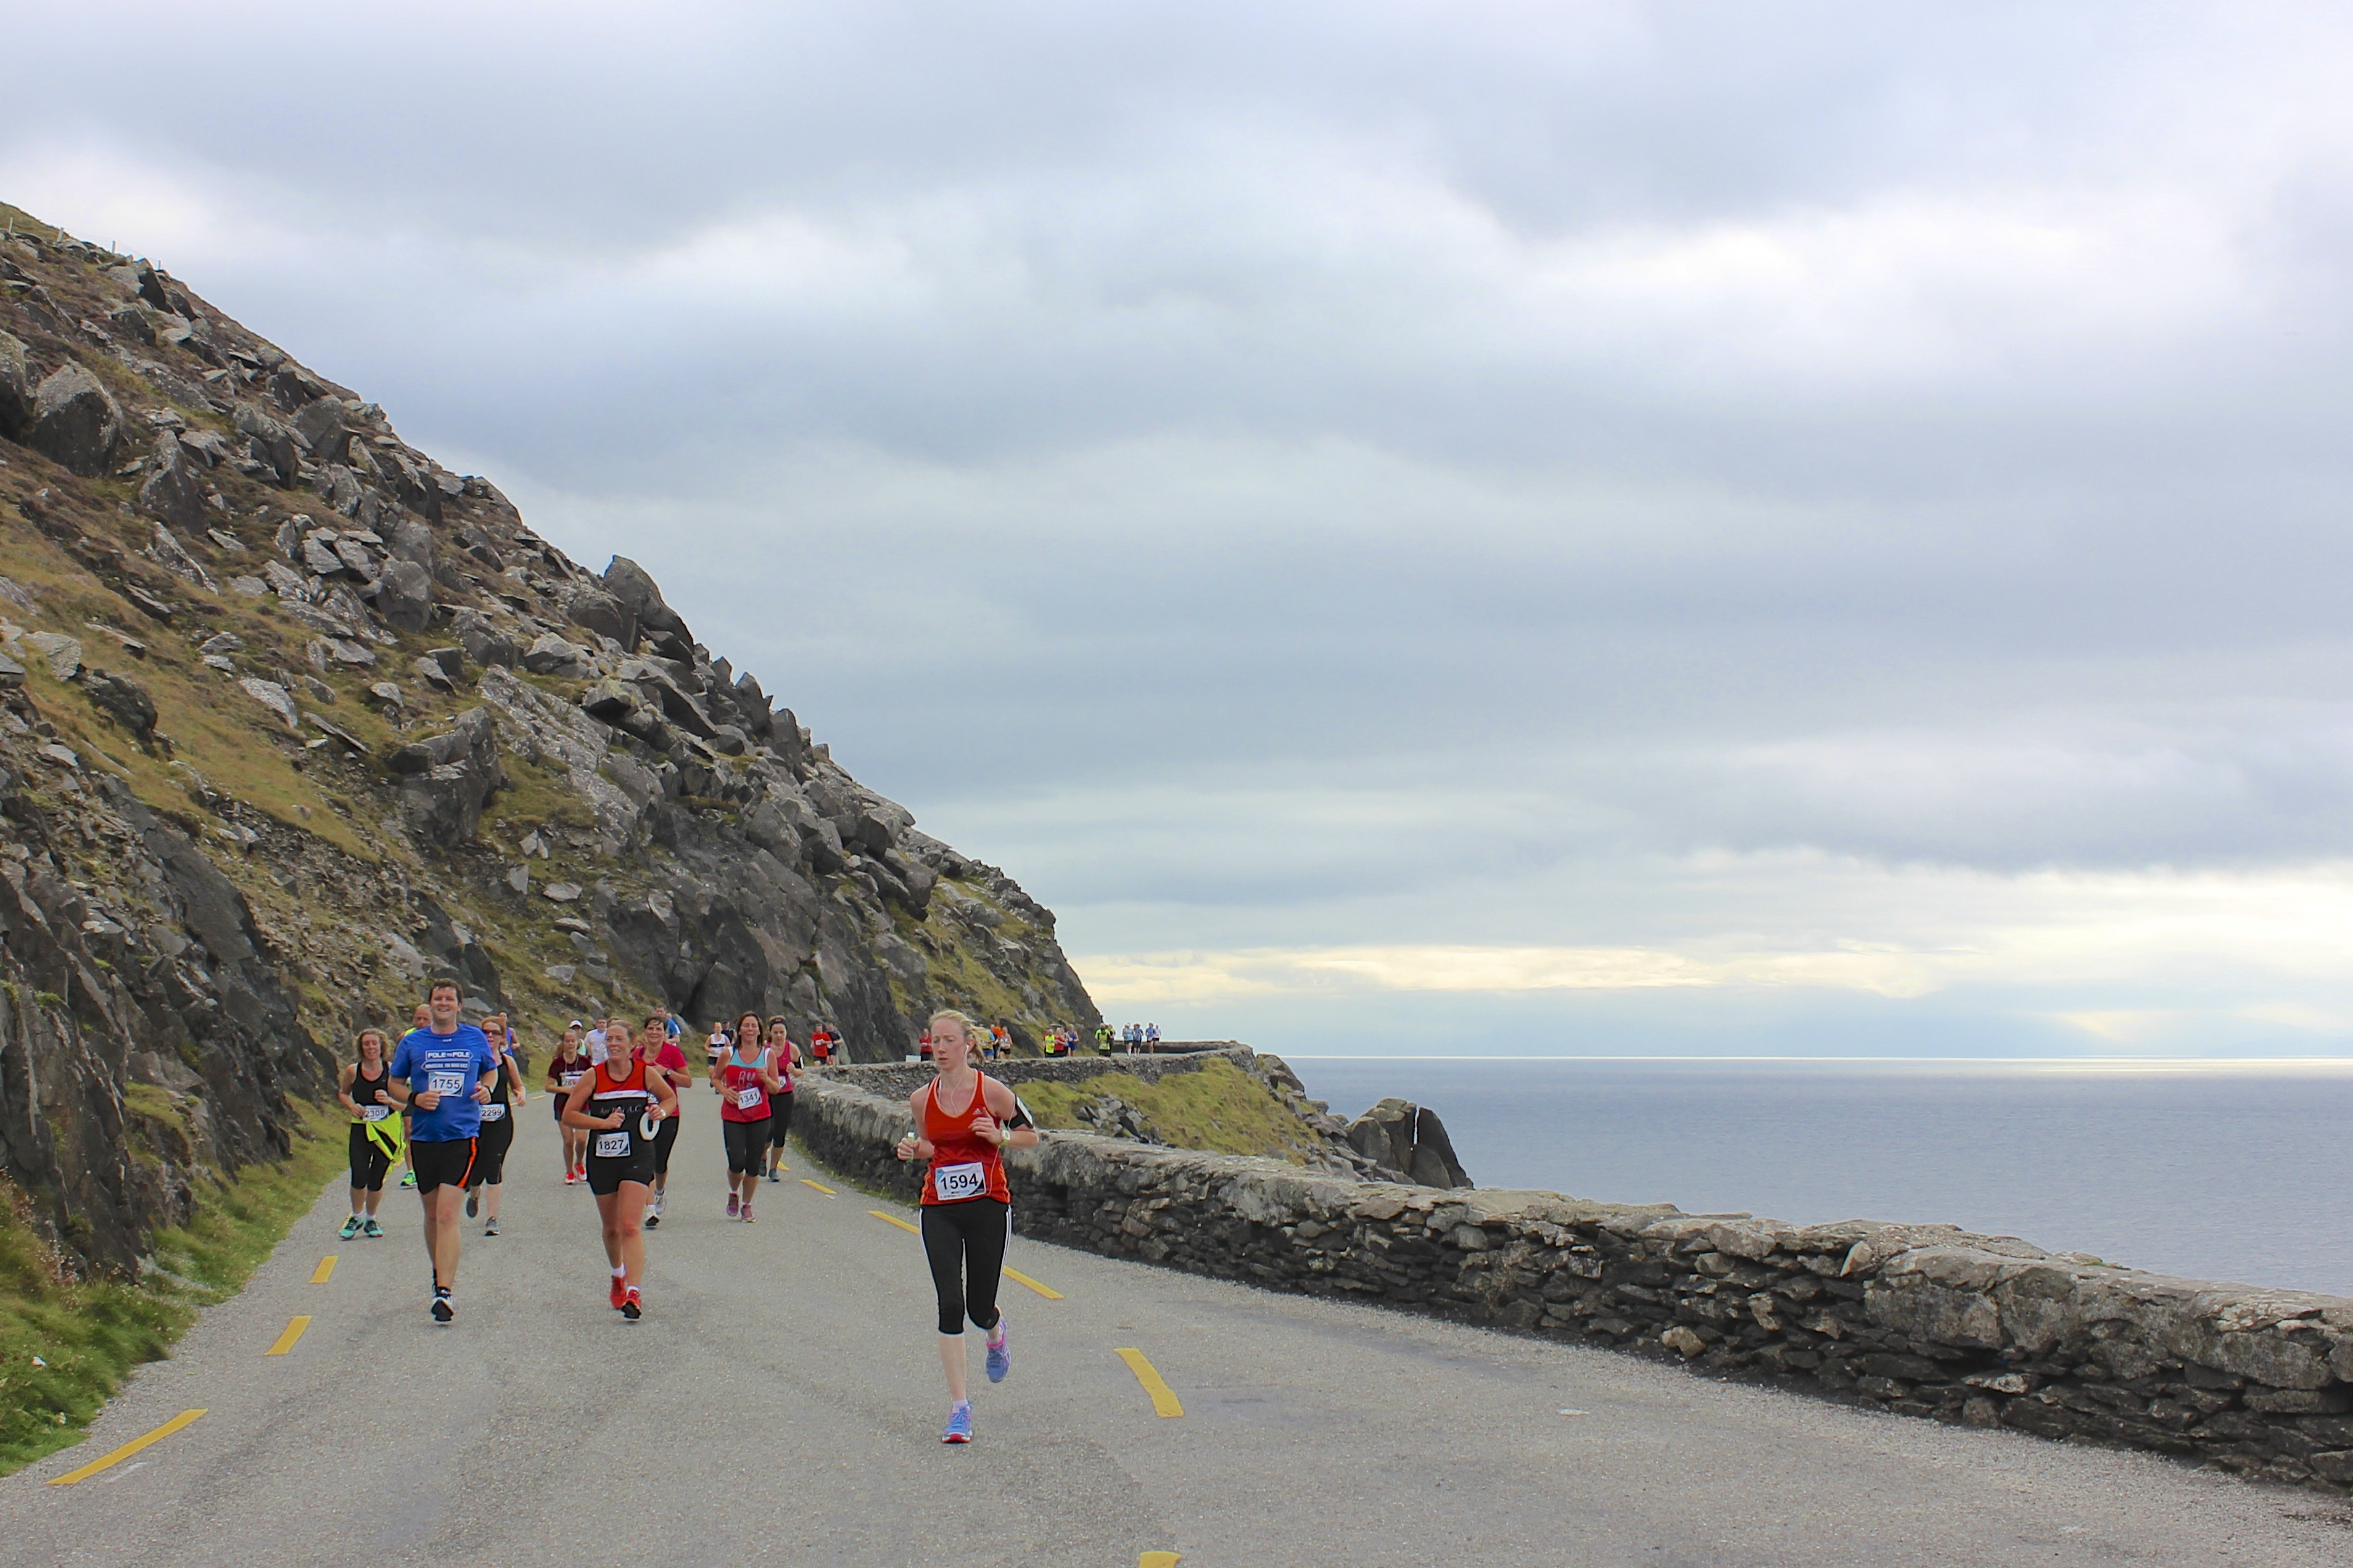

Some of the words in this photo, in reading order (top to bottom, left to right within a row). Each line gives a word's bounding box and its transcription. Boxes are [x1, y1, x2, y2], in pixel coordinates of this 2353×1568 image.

[432, 1078, 460, 1089] 1755
[740, 1092, 759, 1104] 1341
[365, 1109, 385, 1118] 2308
[599, 1139, 624, 1150] 1827
[941, 1173, 979, 1190] 1594
